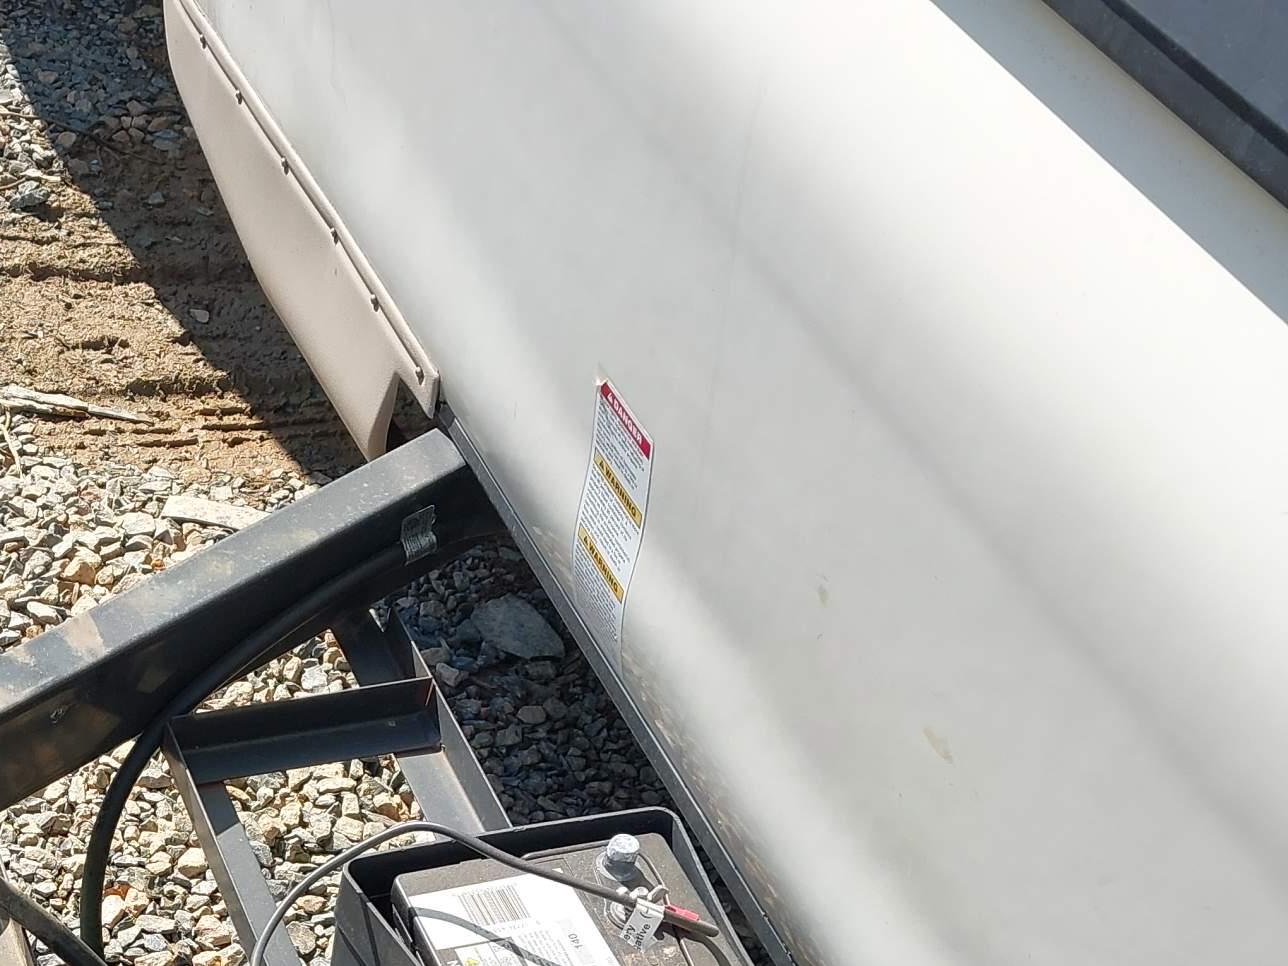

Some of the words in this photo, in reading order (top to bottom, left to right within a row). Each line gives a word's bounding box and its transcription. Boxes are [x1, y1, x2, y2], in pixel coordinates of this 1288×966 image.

[612, 399, 643, 444] DANGER
[604, 467, 637, 518] WARNING
[587, 544, 619, 594] WARNING
[567, 932, 584, 949] 140
